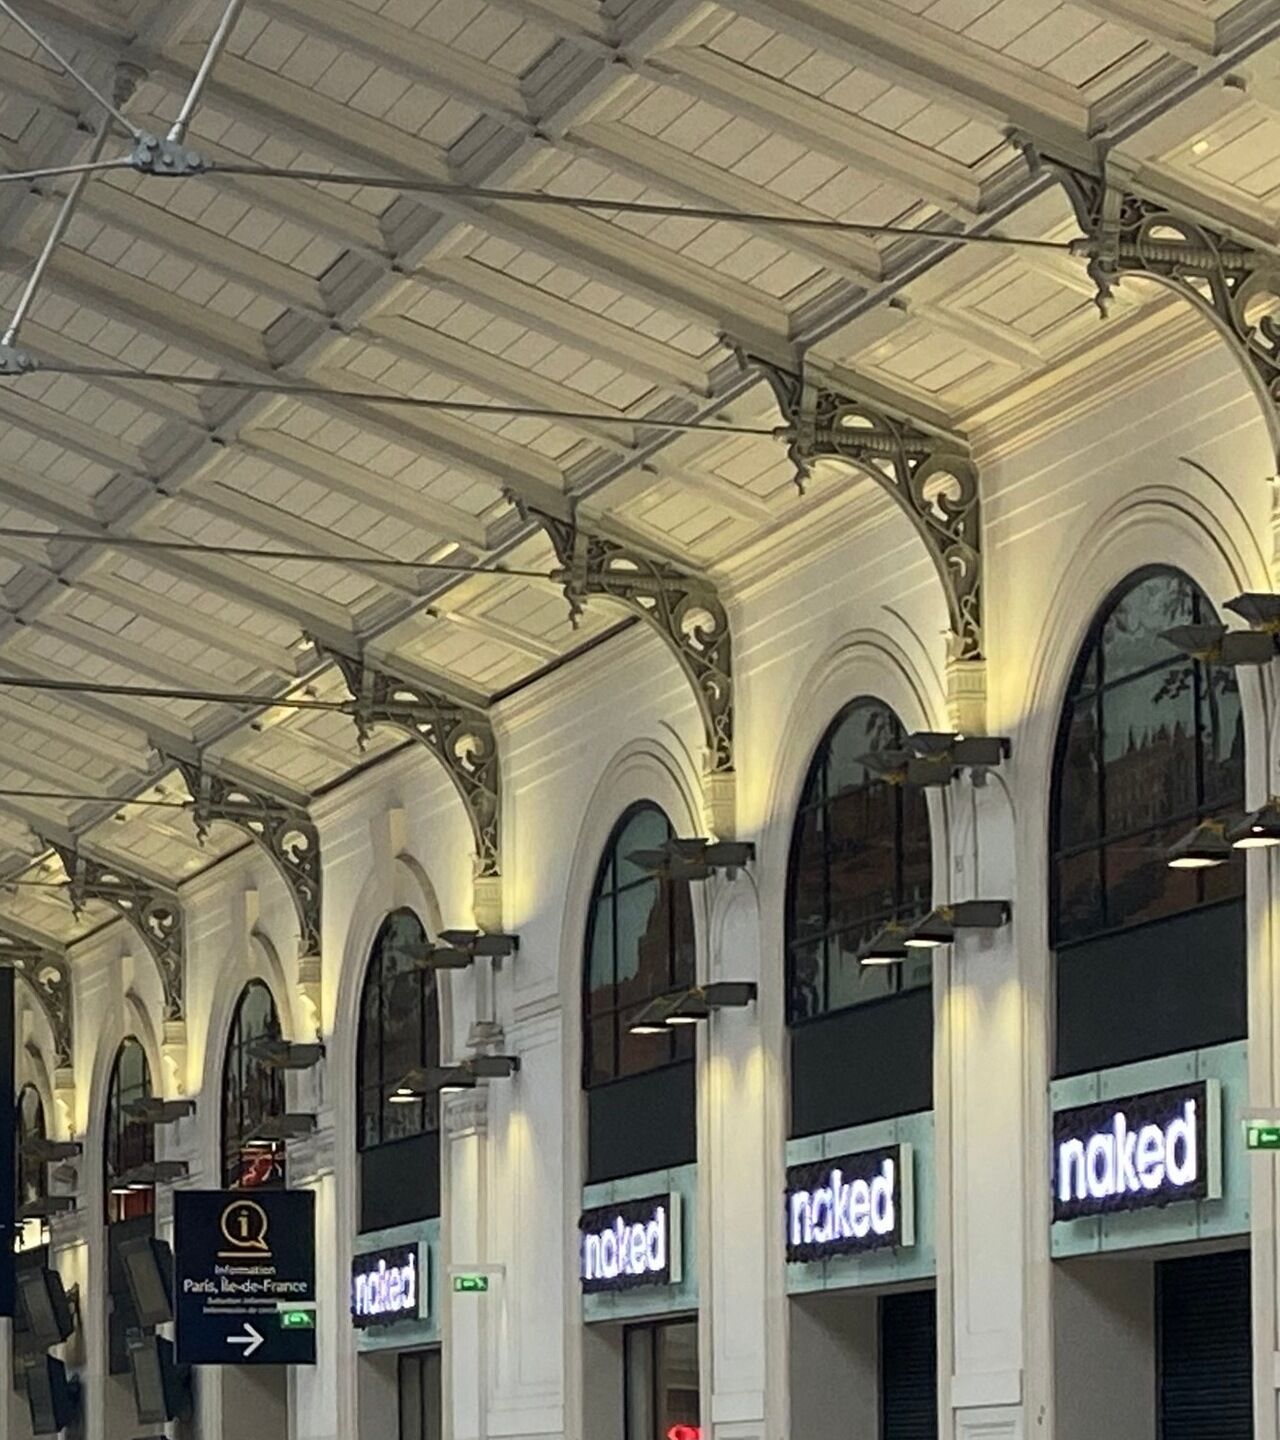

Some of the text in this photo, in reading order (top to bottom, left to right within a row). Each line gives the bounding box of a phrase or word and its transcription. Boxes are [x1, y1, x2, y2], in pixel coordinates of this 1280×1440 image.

[1059, 1098, 1197, 1202] naked
[790, 1157, 895, 1244] naked
[584, 1206, 665, 1279] naked
[183, 1276, 307, 1293] Paris, Île-de-France
[355, 1251, 415, 1315] naked
